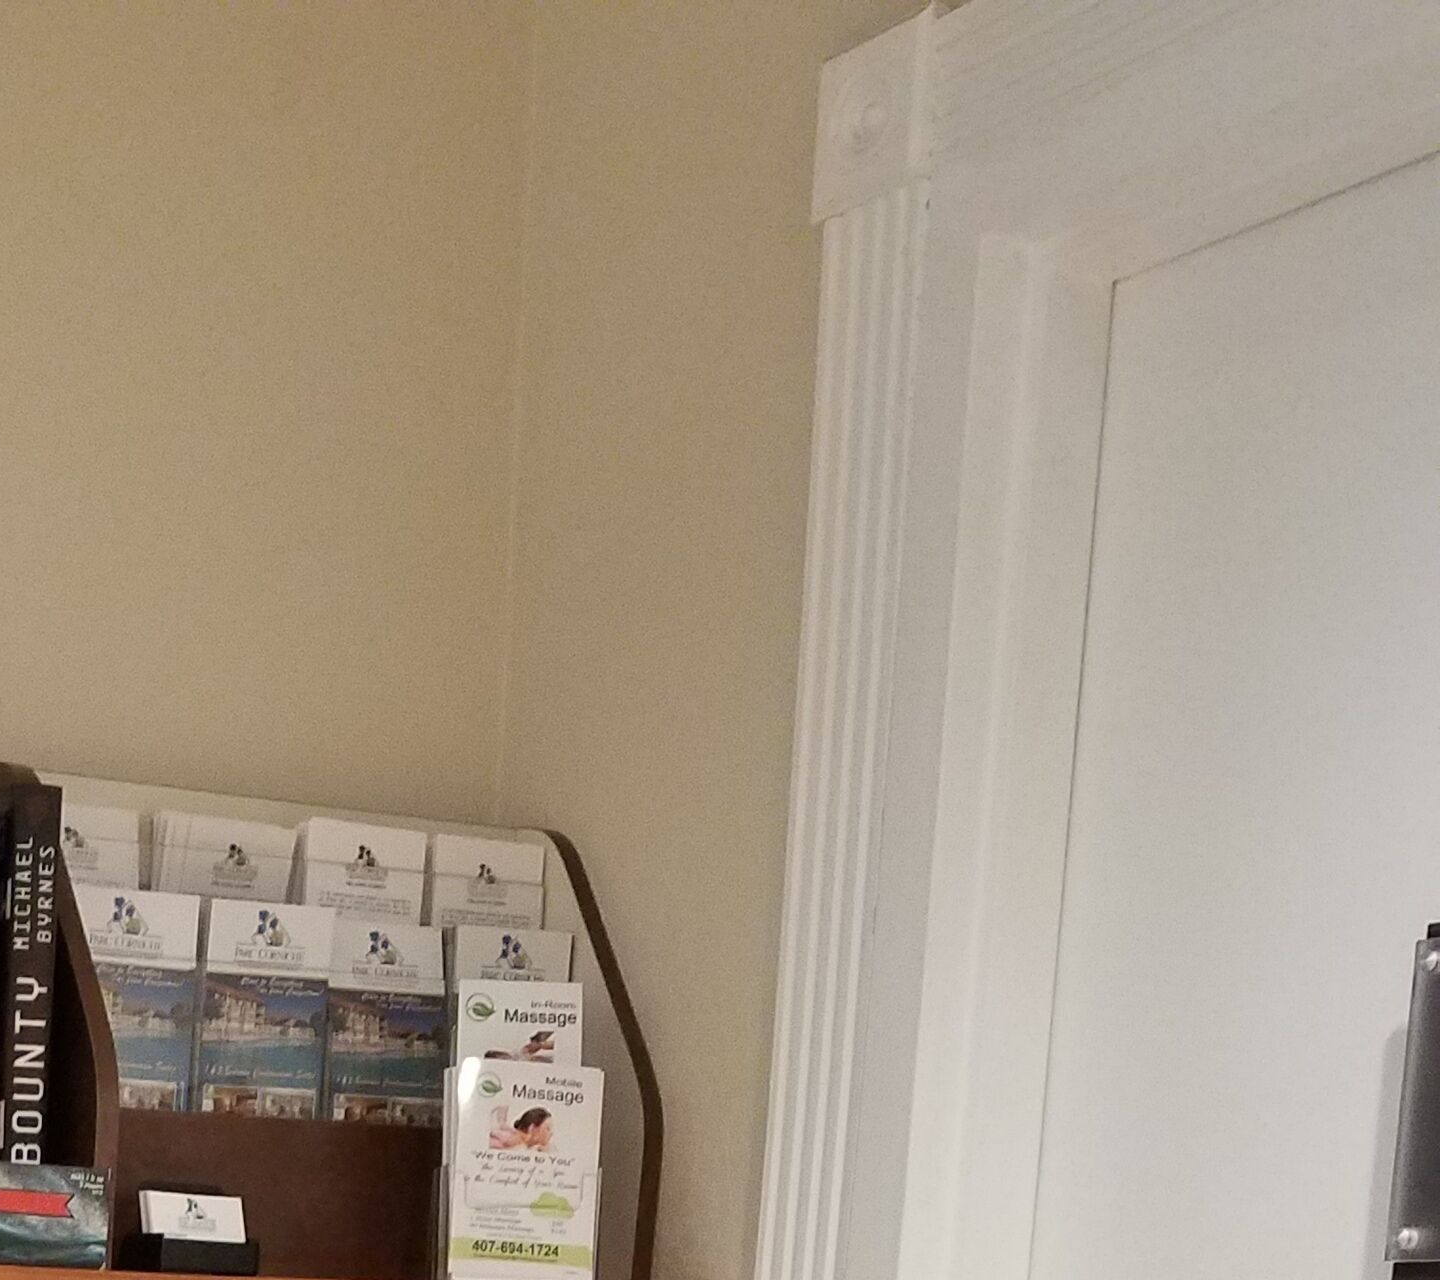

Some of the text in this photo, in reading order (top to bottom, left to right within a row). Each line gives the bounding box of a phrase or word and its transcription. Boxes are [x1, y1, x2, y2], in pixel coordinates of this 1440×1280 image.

[13, 837, 33, 951] MICHAEL
[37, 846, 56, 944] BYRNES
[503, 1009, 578, 1027] Massage
[10, 976, 49, 1166] BOUNTY
[545, 1077, 583, 1088] Mobile
[512, 1084, 585, 1106] Massage
[497, 1151, 531, 1163] Come
[534, 1153, 546, 1164] to
[472, 1239, 560, 1258] 407-694-1724
